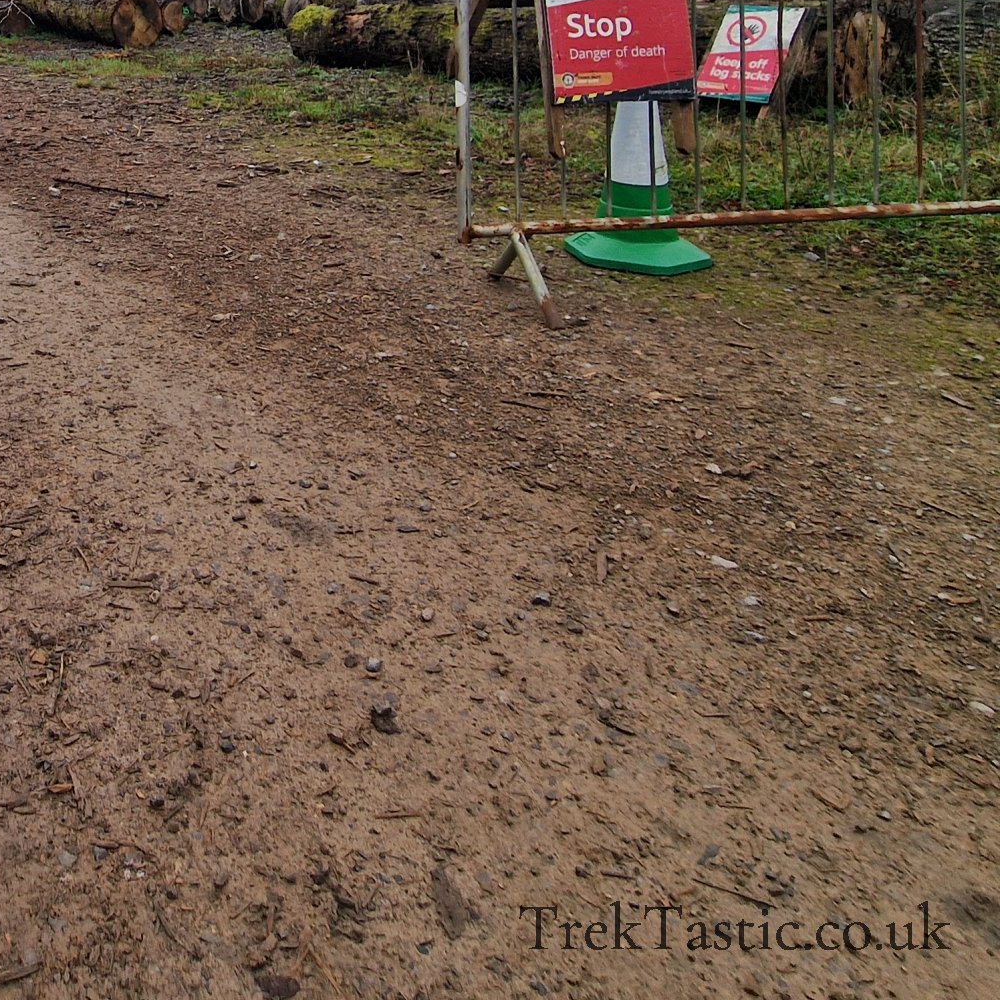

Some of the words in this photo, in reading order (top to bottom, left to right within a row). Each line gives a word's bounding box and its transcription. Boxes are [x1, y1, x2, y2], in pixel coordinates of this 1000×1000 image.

[566, 12, 632, 42] Stop
[569, 47, 613, 62] Danger
[616, 45, 629, 58] of
[631, 44, 666, 58] death
[748, 58, 769, 69] off
[709, 66, 729, 80] log
